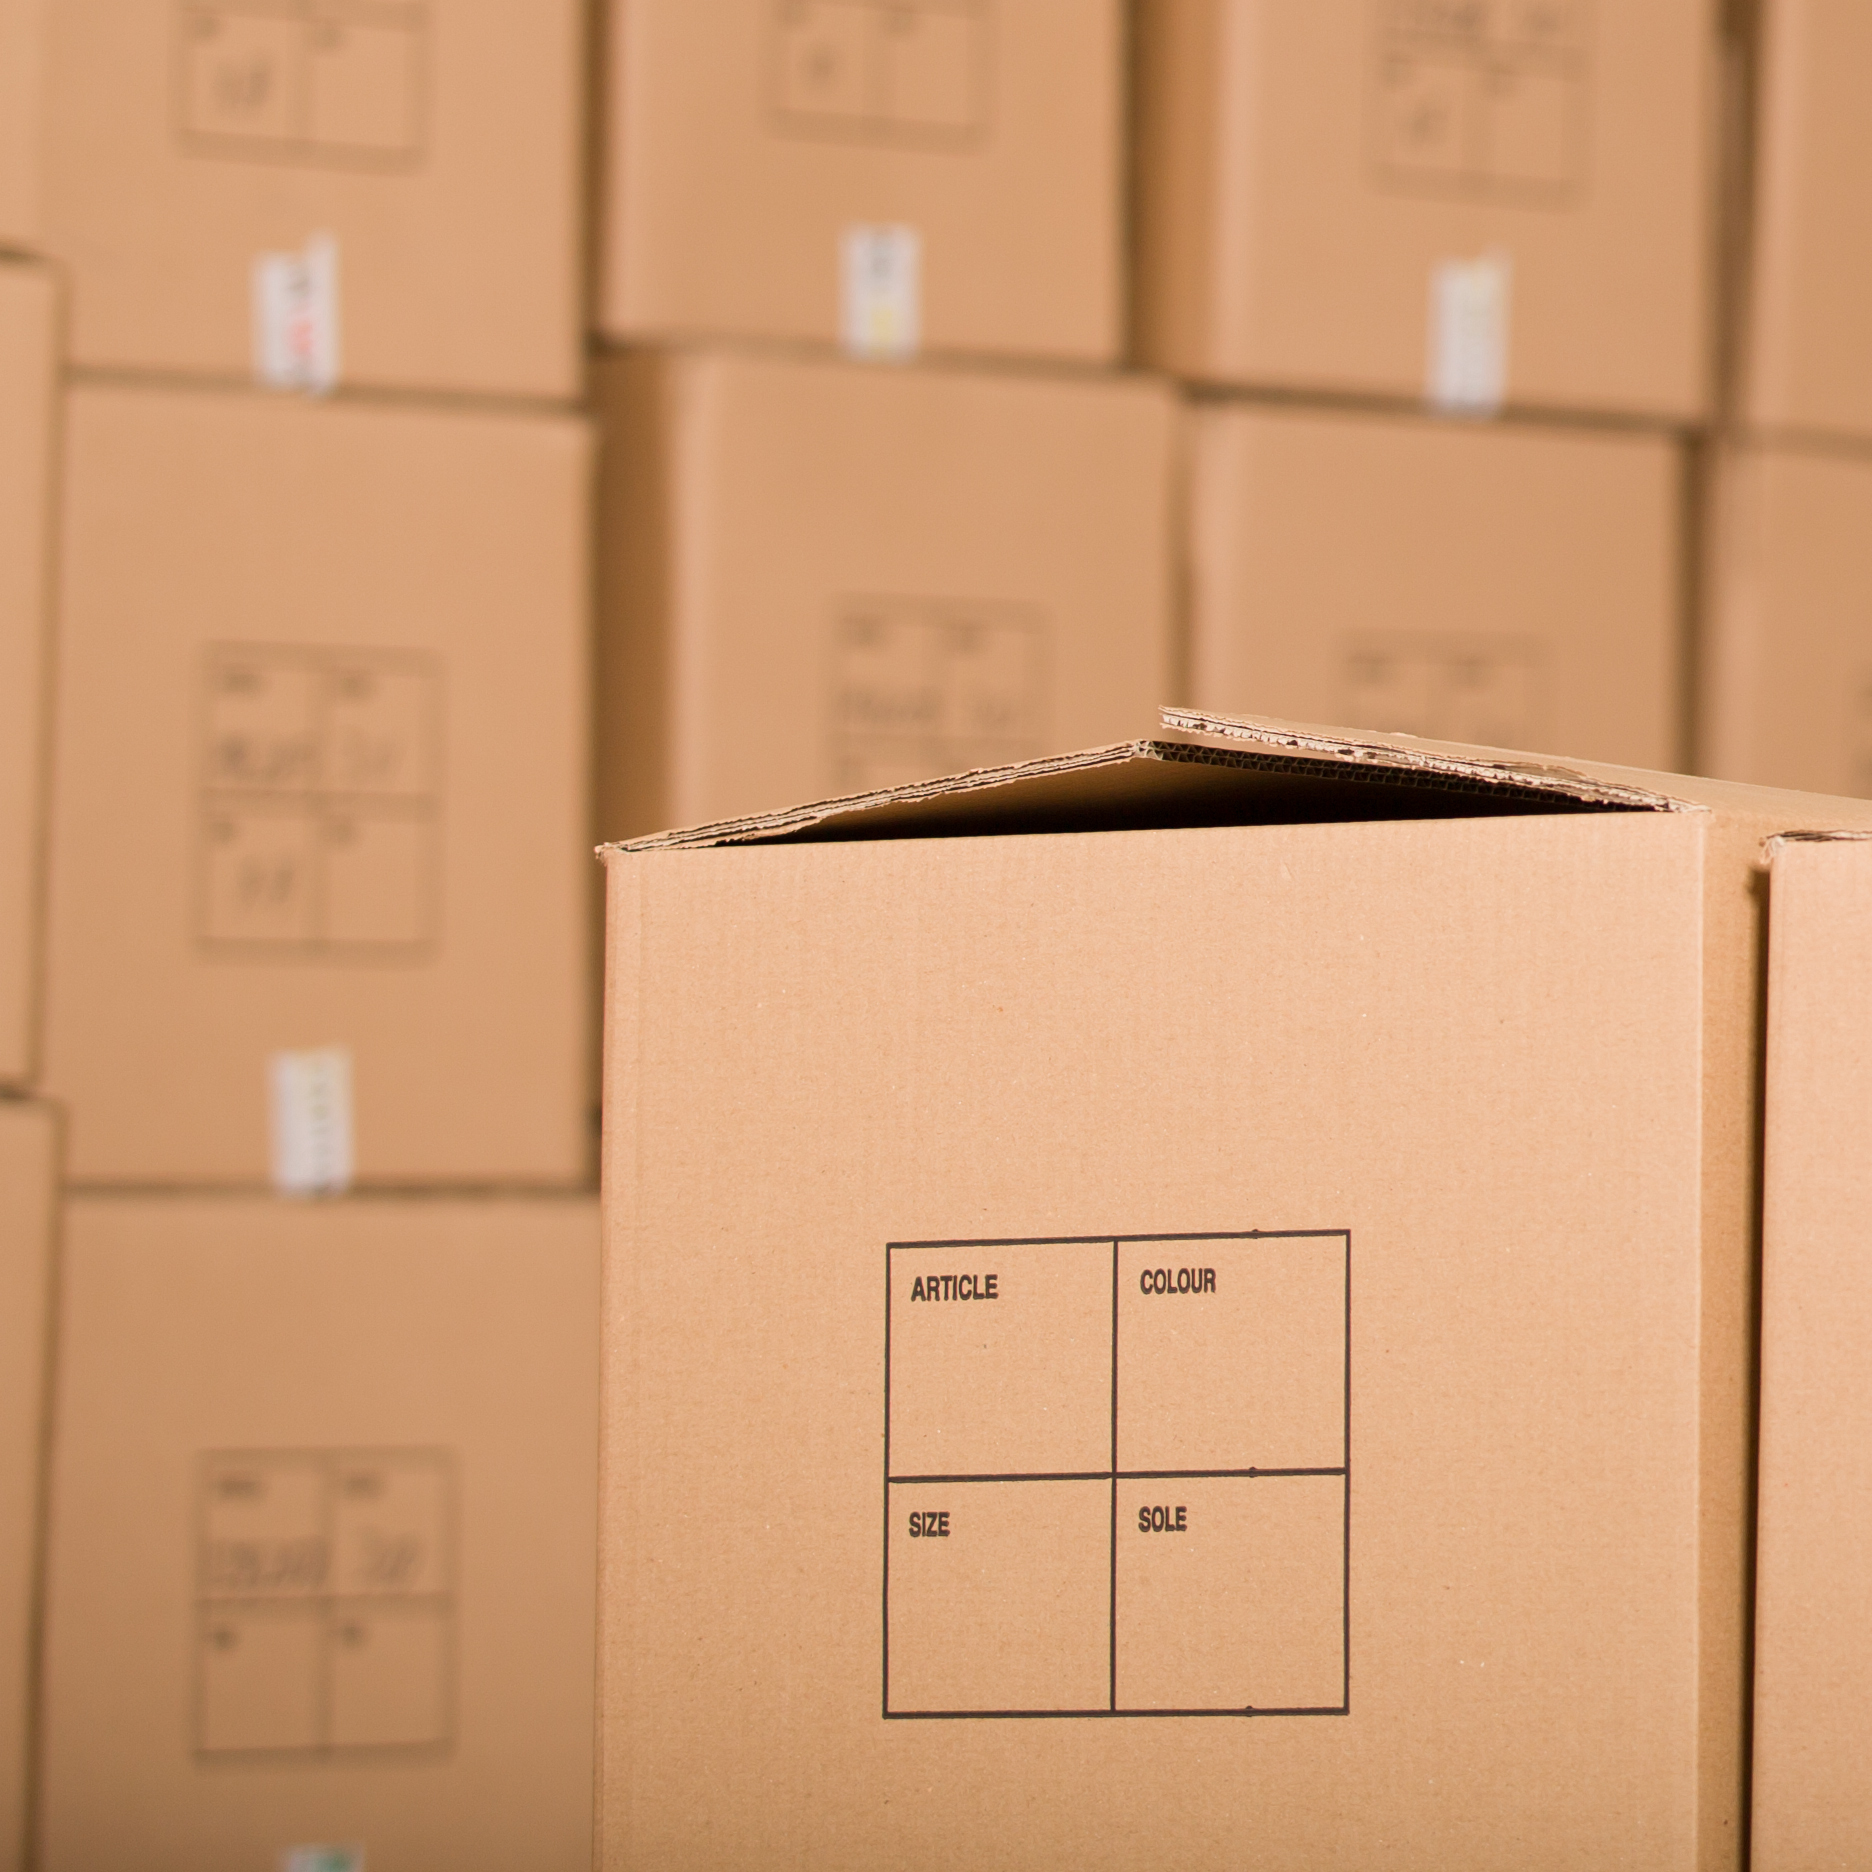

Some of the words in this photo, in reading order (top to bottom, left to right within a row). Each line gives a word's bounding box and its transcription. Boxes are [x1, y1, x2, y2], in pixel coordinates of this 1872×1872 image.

[910, 1274, 999, 1302] ARTICLE
[1140, 1267, 1217, 1295] COLOUR
[908, 1511, 951, 1538] SIZE
[1138, 1505, 1188, 1533] SOLE
